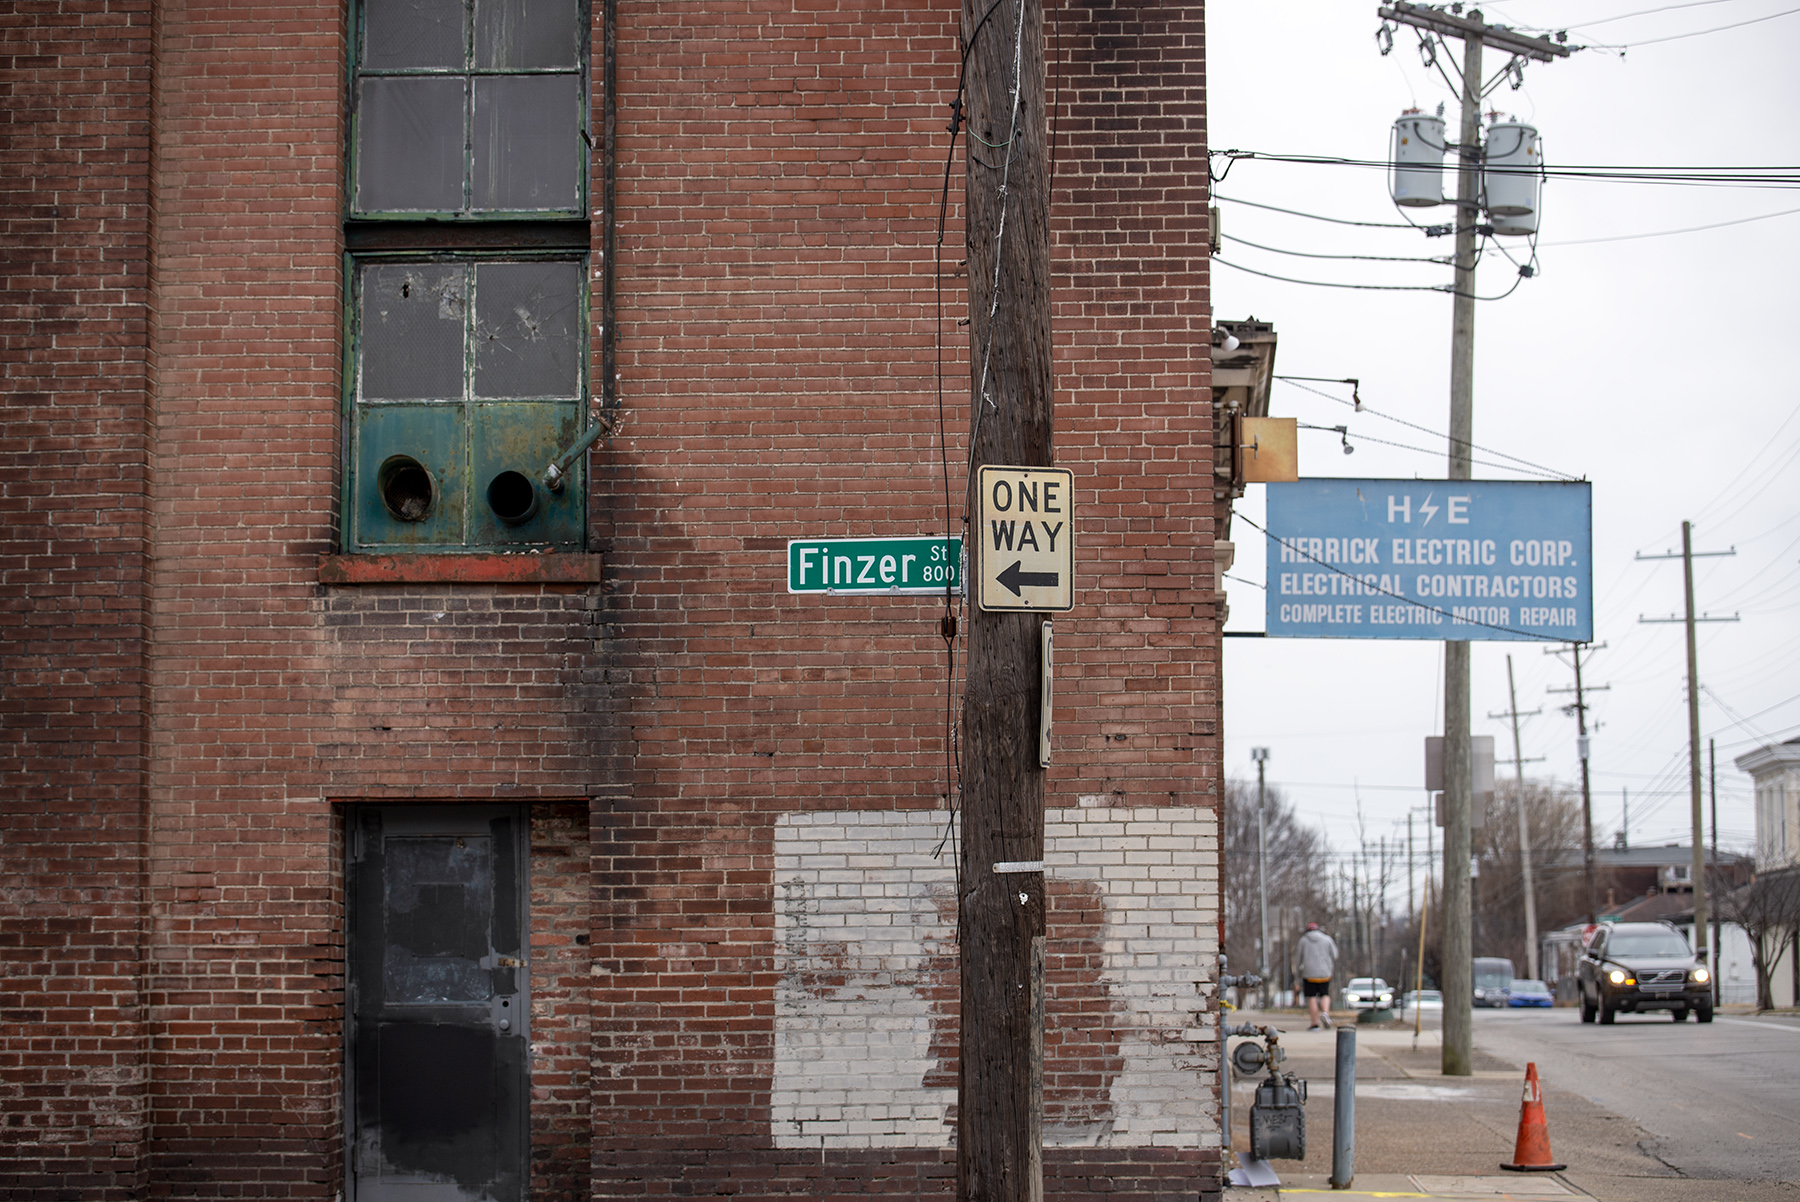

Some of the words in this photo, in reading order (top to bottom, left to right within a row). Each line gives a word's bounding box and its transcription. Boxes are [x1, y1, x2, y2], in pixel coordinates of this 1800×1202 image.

[992, 480, 1062, 513] ONE
[1387, 495, 1411, 524] H
[1448, 496, 1470, 525] E
[991, 519, 1063, 553] WAY
[799, 547, 917, 585] Finzer
[930, 545, 948, 562] St
[1280, 537, 1380, 565] HERRICK
[1392, 538, 1496, 566] ELECTRIC
[1510, 540, 1578, 567] CORP.
[923, 565, 955, 582] 800
[1280, 573, 1405, 596] ELECTRICAL
[1416, 574, 1578, 599] CONTRACTORS
[1280, 604, 1362, 624] COMPLETE
[1370, 605, 1443, 625] ELECTRIC
[1452, 606, 1510, 626] MOTOR
[1520, 607, 1578, 627] REPAIR
